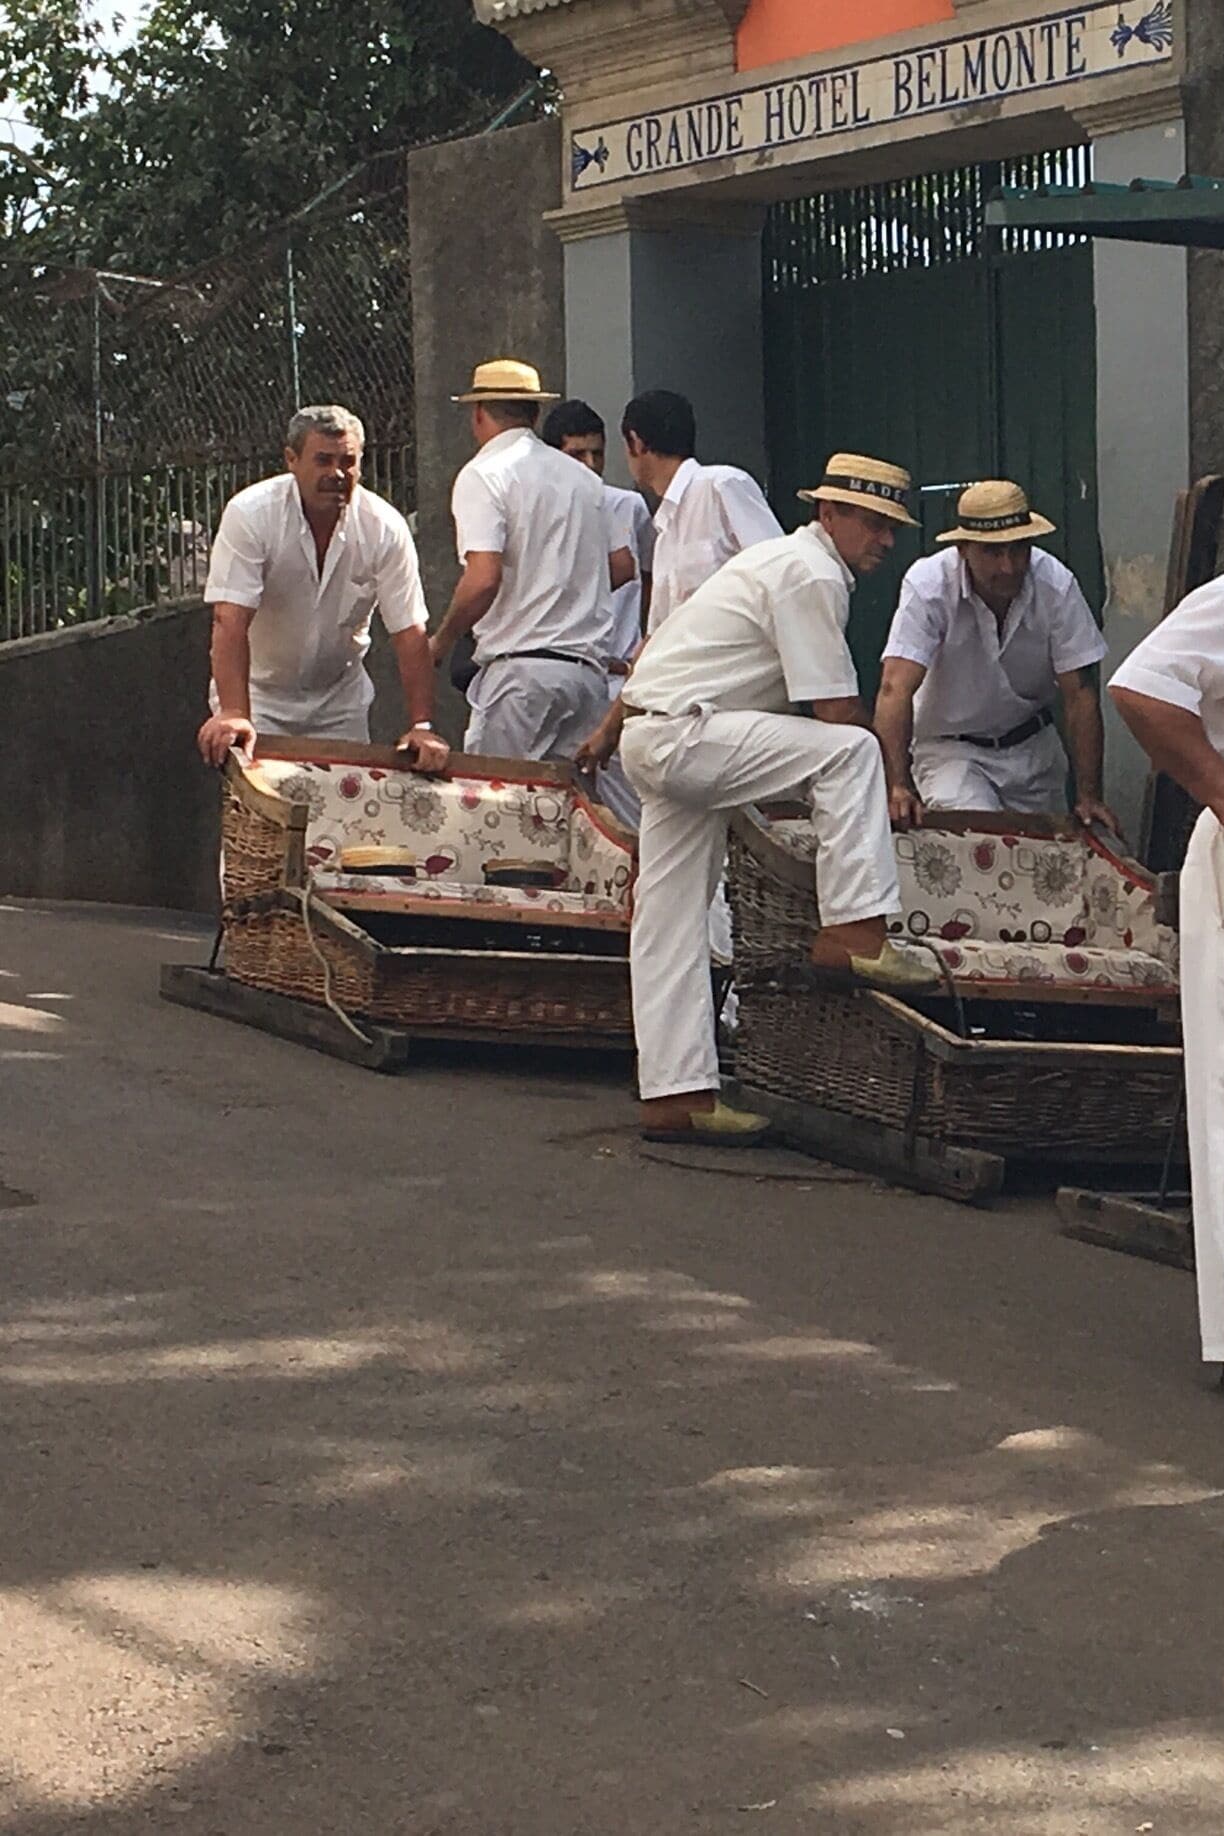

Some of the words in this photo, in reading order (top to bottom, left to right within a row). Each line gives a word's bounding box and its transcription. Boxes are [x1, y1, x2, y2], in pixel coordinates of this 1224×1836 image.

[626, 98, 744, 172] GRANDE
[764, 70, 871, 143] HOTEL
[893, 16, 1087, 116] BELMONTE
